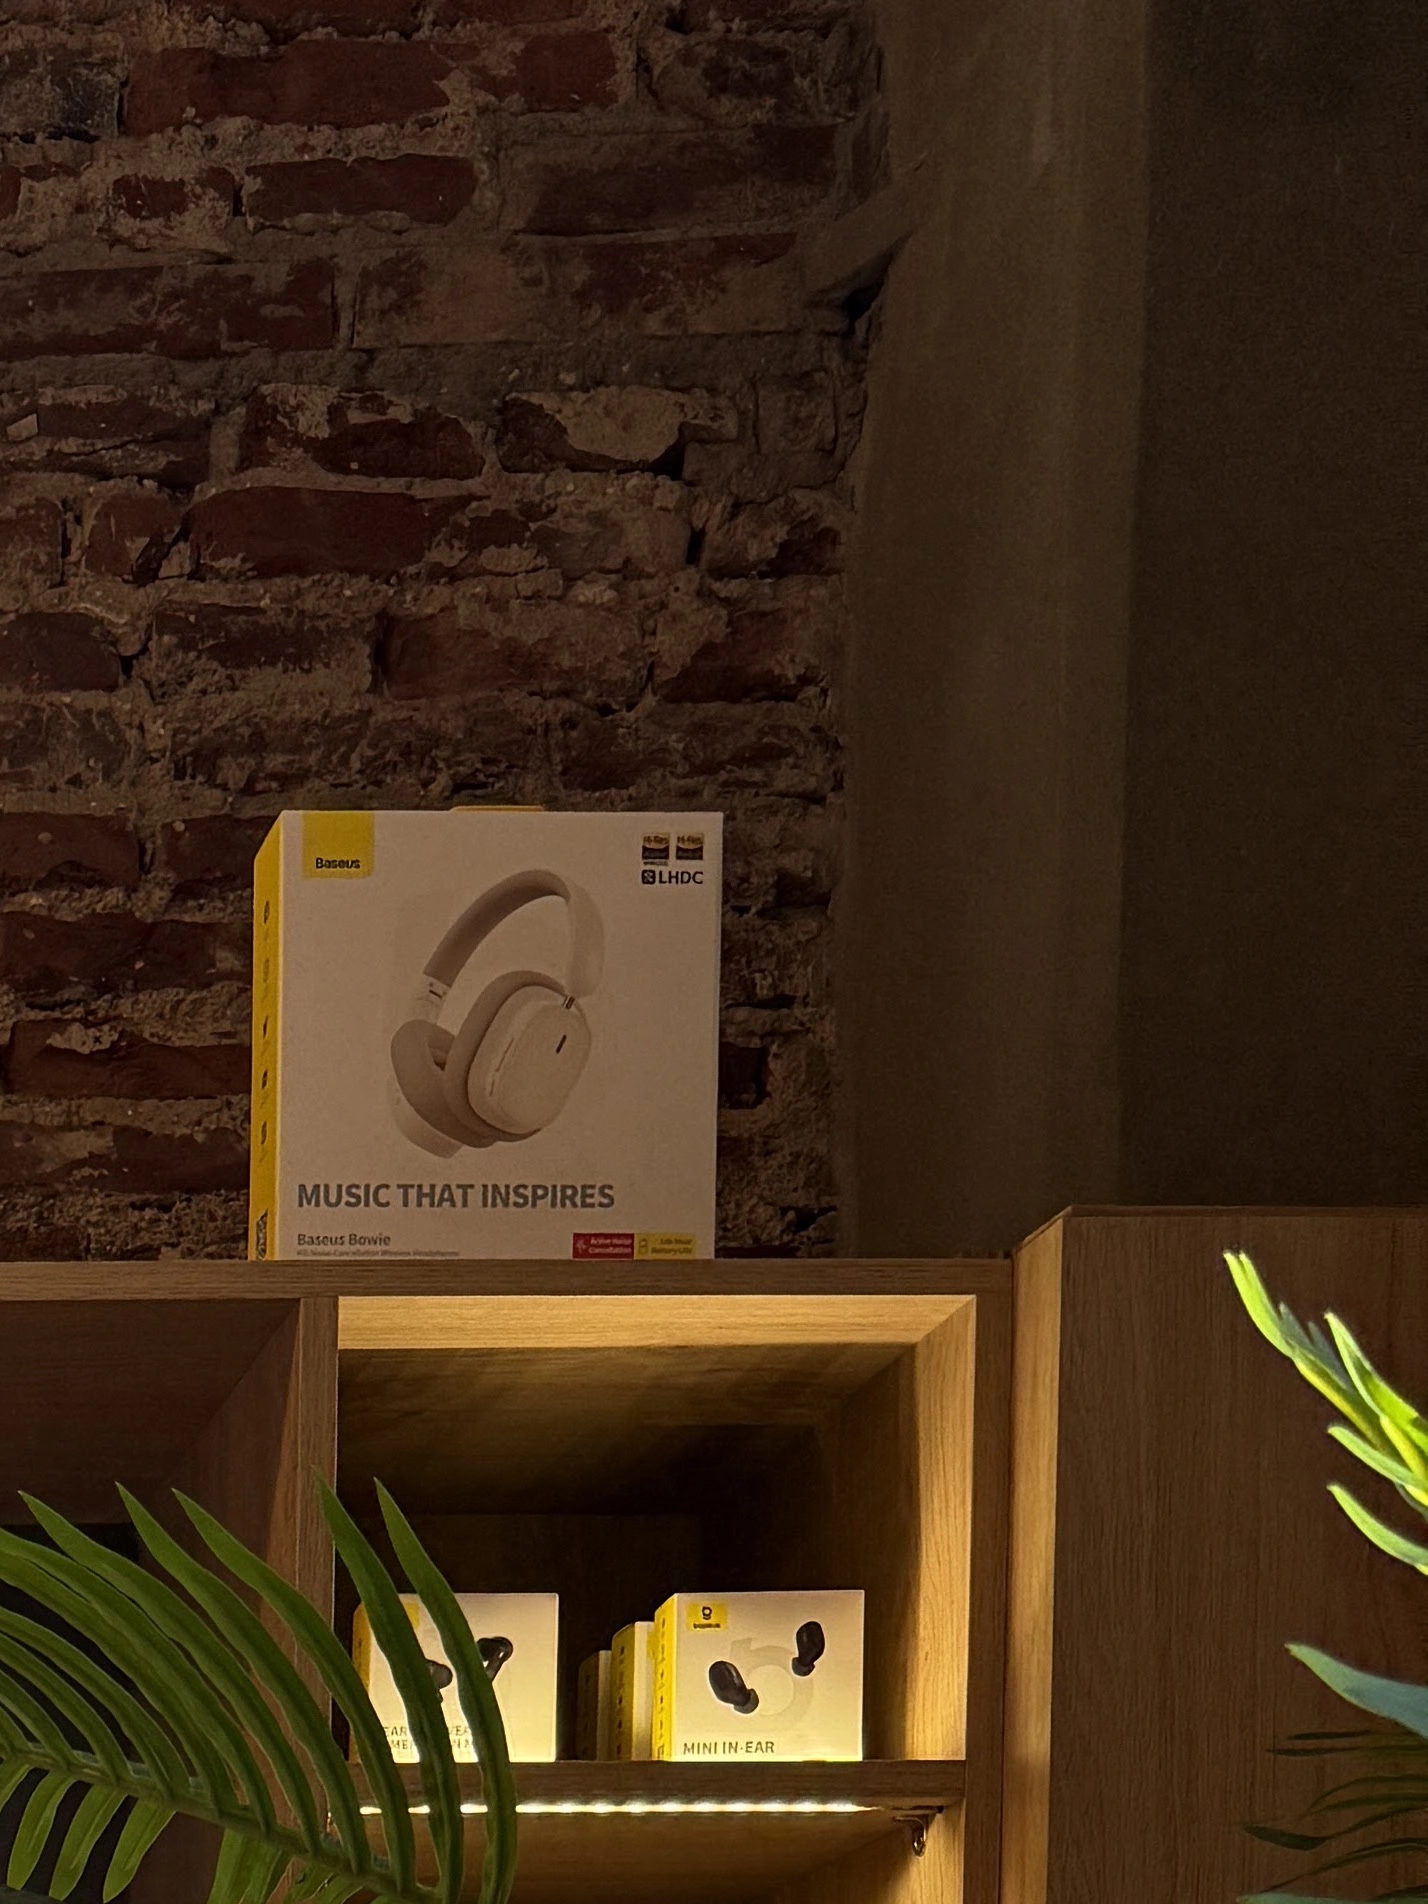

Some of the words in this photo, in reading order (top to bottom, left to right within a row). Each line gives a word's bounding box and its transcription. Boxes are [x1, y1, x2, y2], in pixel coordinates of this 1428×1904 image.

[315, 858, 361, 870] Baseus
[658, 871, 704, 884] LHDC
[297, 1183, 391, 1208] MUSIC
[397, 1183, 474, 1208] THAT
[481, 1183, 615, 1208] INSPIRES
[297, 1234, 345, 1246] Baseus
[348, 1233, 391, 1246] Bowie
[683, 1742, 717, 1755] MINI
[723, 1741, 775, 1754] IN-EAR
